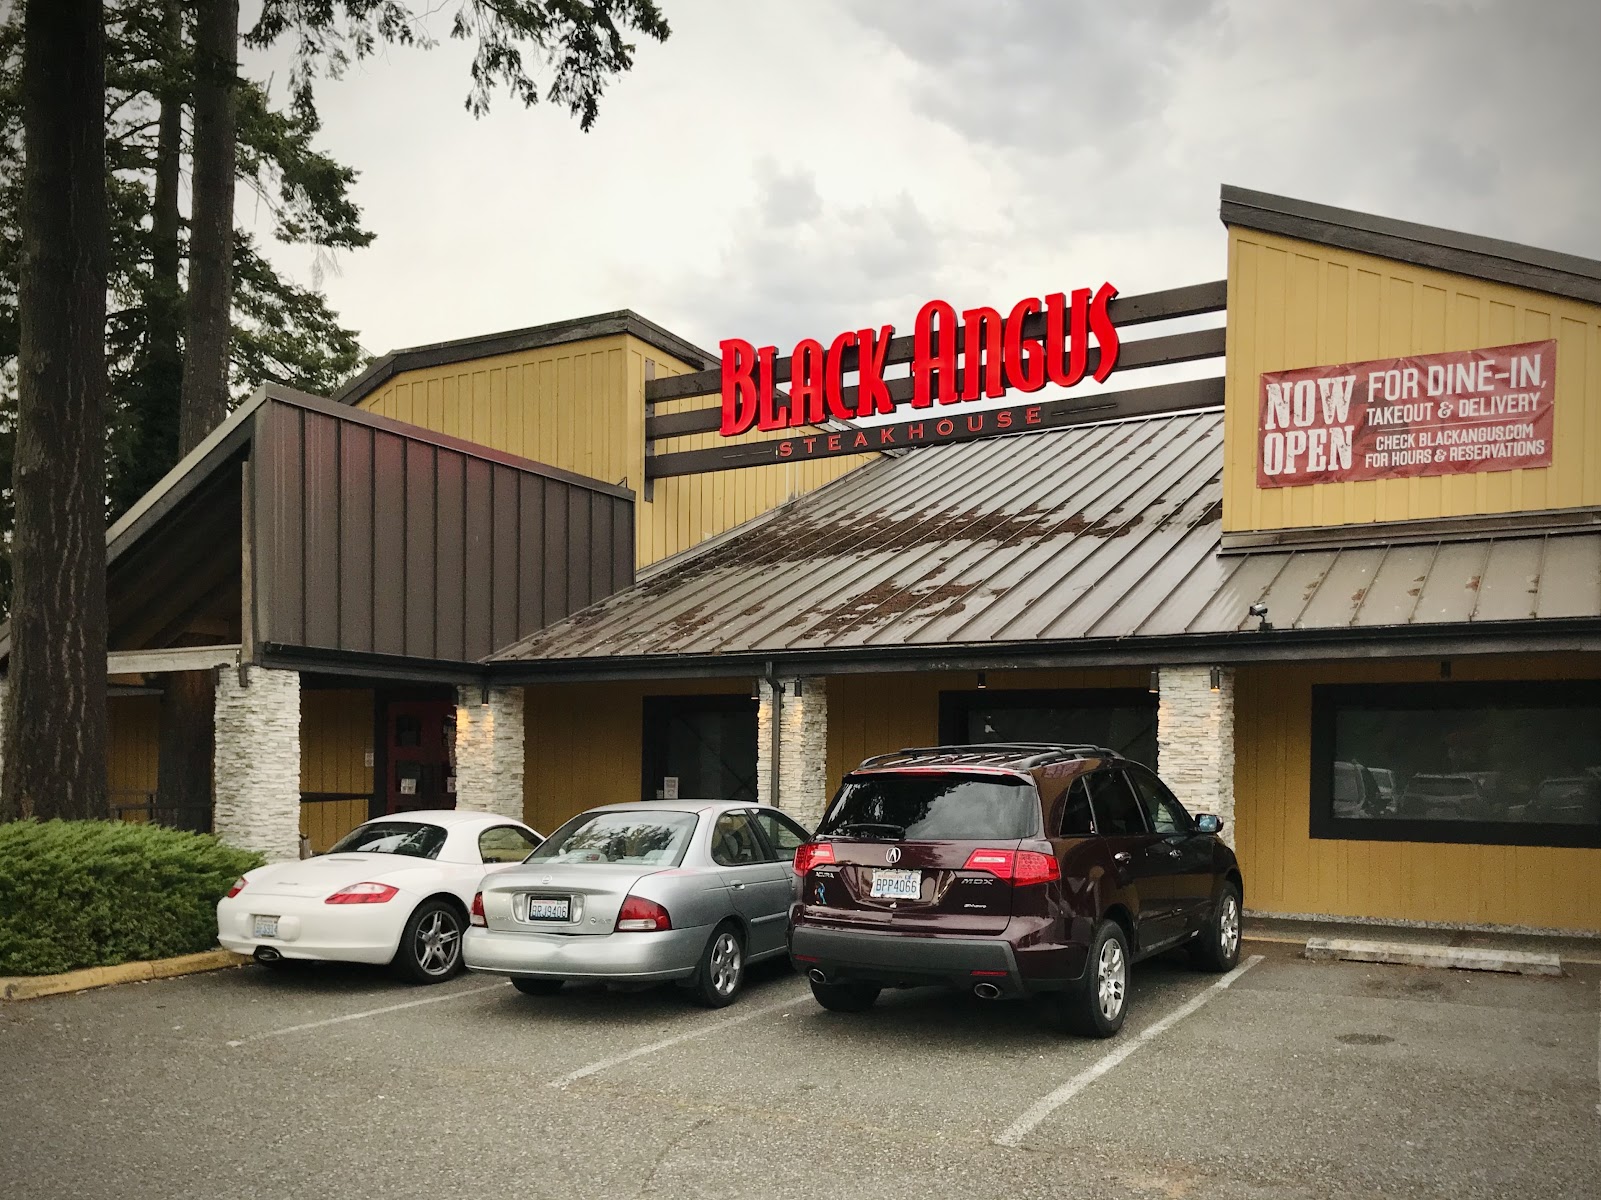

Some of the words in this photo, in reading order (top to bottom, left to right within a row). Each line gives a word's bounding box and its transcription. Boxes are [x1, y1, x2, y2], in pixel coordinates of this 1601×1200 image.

[719, 324, 896, 437] BLACK
[911, 281, 1120, 408] ANGUS
[1367, 368, 1419, 403] FOR
[1427, 354, 1547, 396] DINE-IN,
[1265, 375, 1356, 430] NOW
[1366, 402, 1434, 426] TAKEOUT
[1437, 401, 1453, 419] &
[1458, 392, 1541, 418] DELIVERY
[779, 406, 1042, 457] STEAKHOUSE
[1264, 425, 1354, 475] OPEN
[1365, 453, 1388, 468] FOR
[1391, 449, 1432, 466] HOURS
[1434, 449, 1447, 463] &
[1450, 440, 1545, 461] RESERVATIONS
[1375, 433, 1415, 451] CHECK
[1419, 423, 1534, 447] BLACKANGUS.COM
[875, 878, 917, 893] BPP4066
